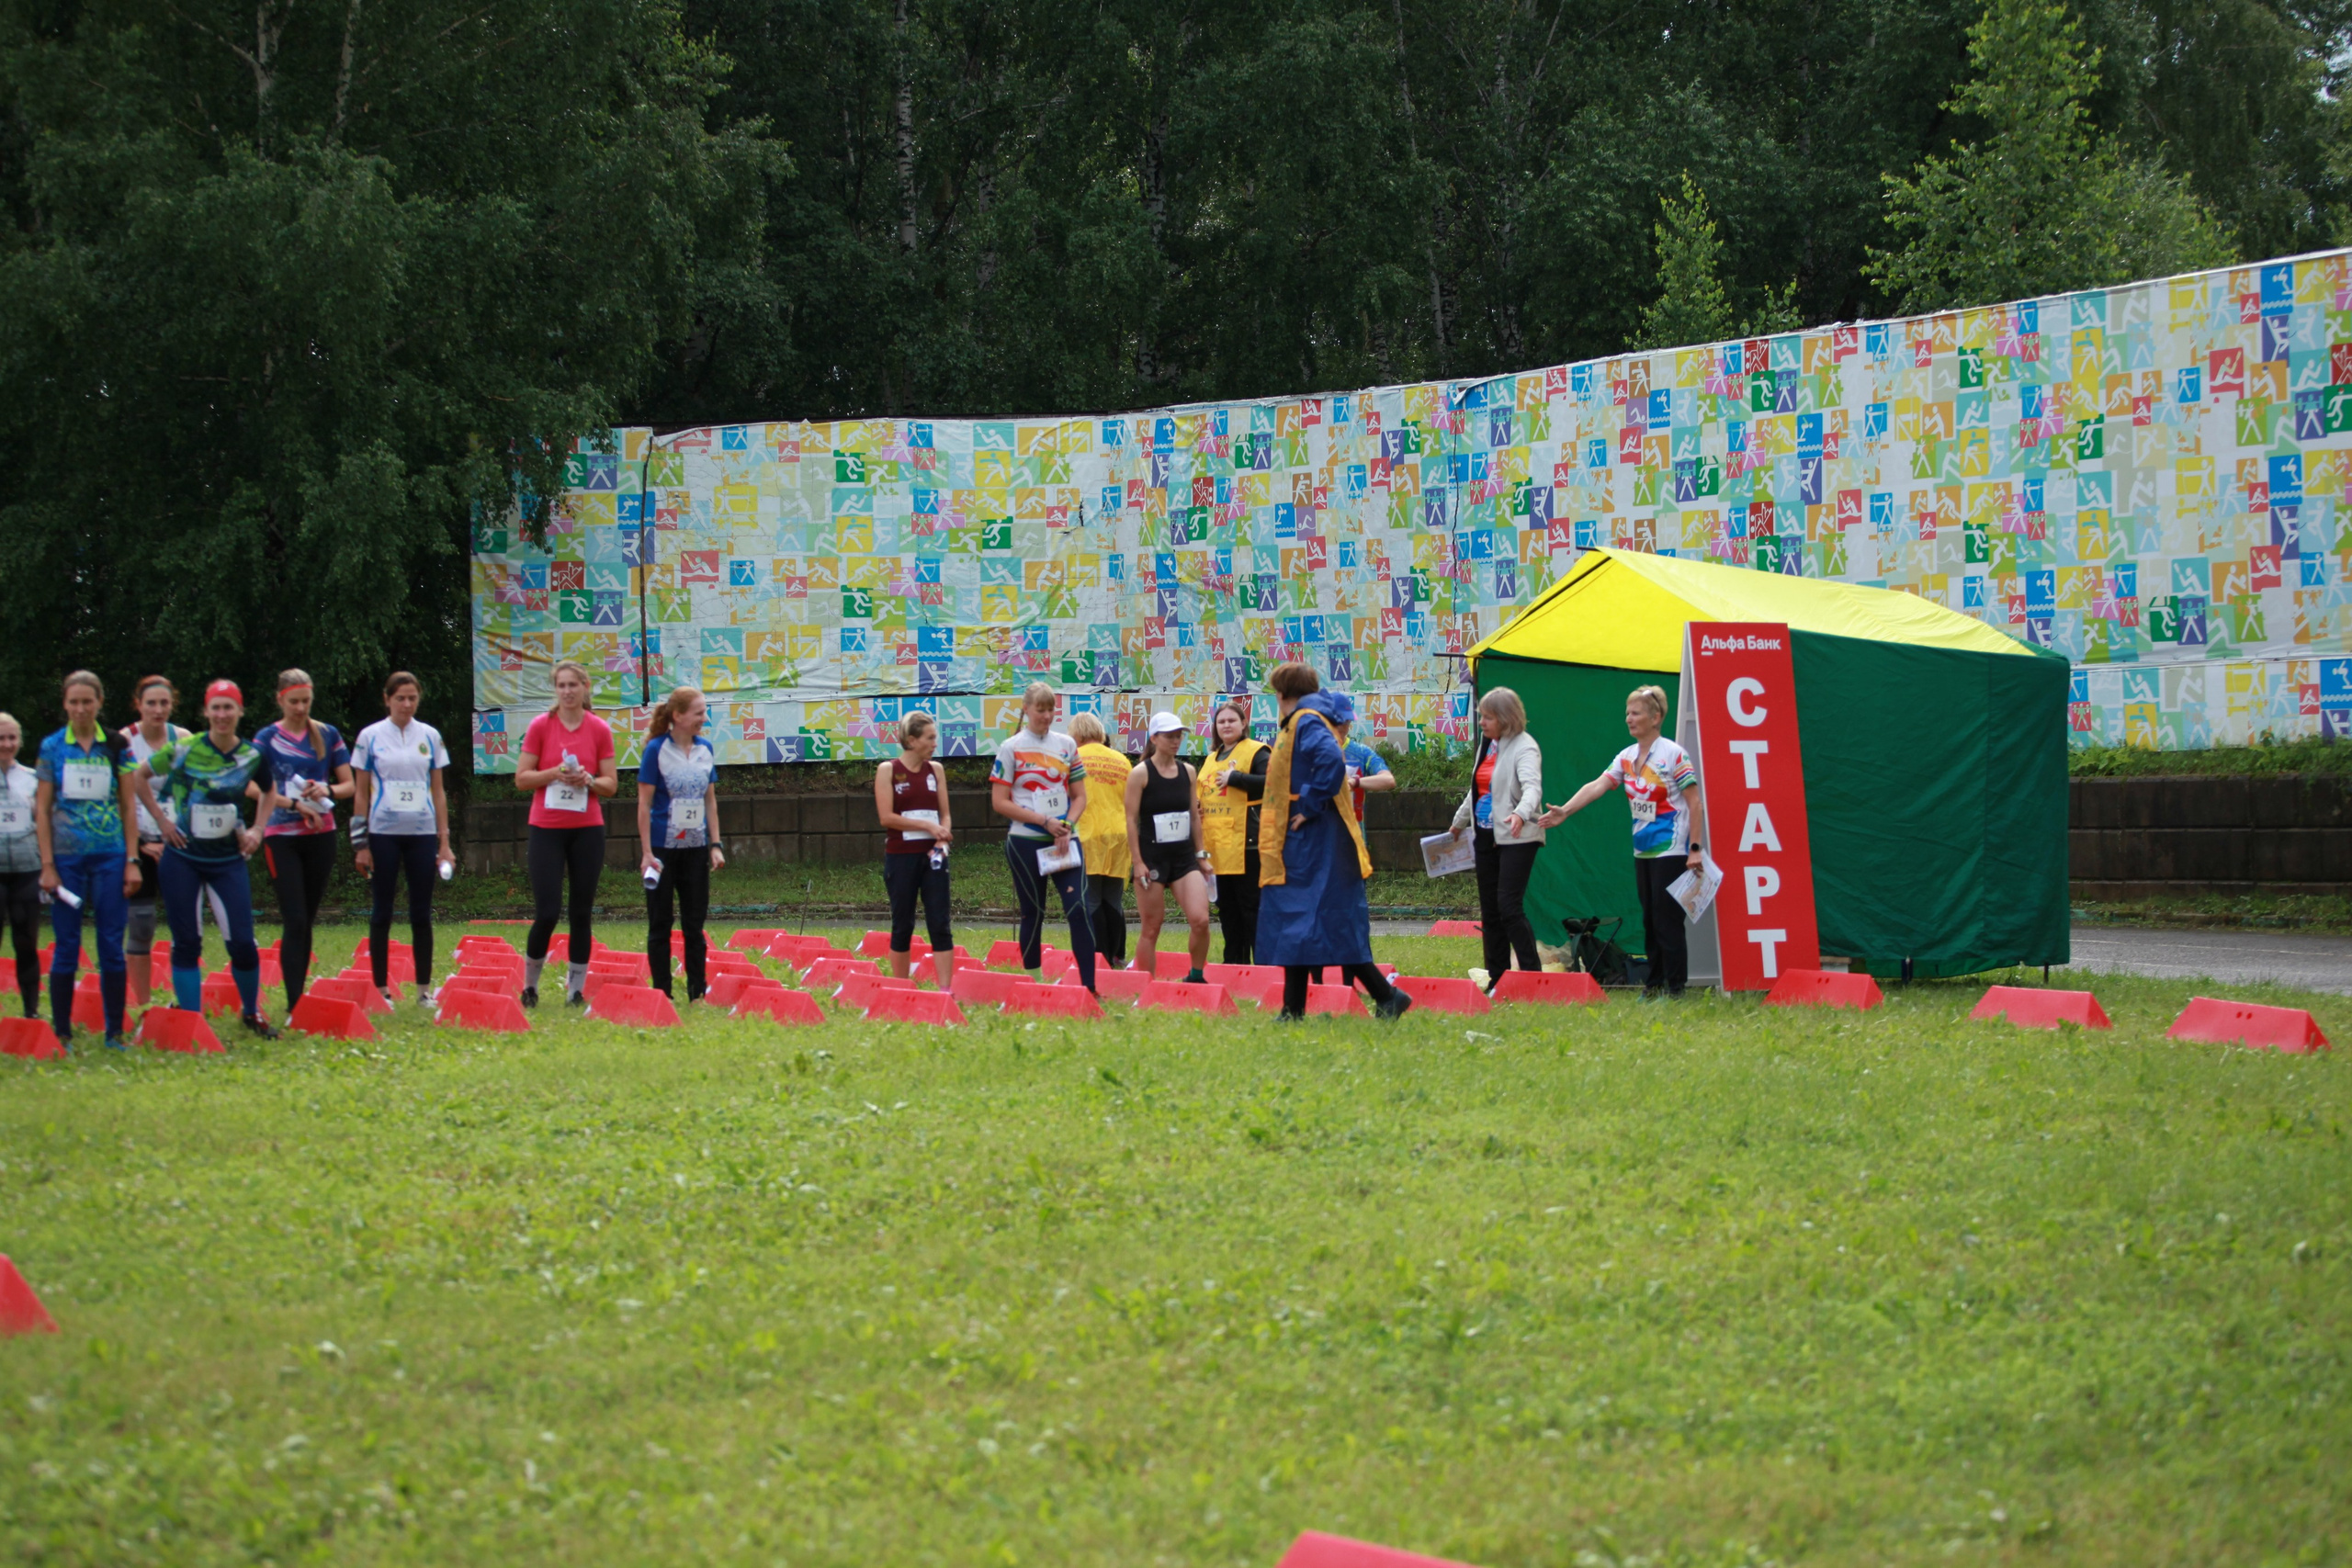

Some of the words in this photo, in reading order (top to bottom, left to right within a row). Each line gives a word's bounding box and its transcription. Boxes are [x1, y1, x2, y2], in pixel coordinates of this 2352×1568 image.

[1701, 634, 1746, 654] Альфа
[1747, 635, 1781, 650] Банк
[79, 777, 92, 788] 11
[399, 791, 413, 802] 23
[560, 789, 574, 800] 22
[1047, 797, 1059, 808] 18
[1633, 802, 1654, 814] 1901
[685, 809, 697, 820] 21
[209, 817, 223, 829] 10
[1168, 820, 1180, 831] 17
[1726, 676, 1787, 978] СТАРТ
